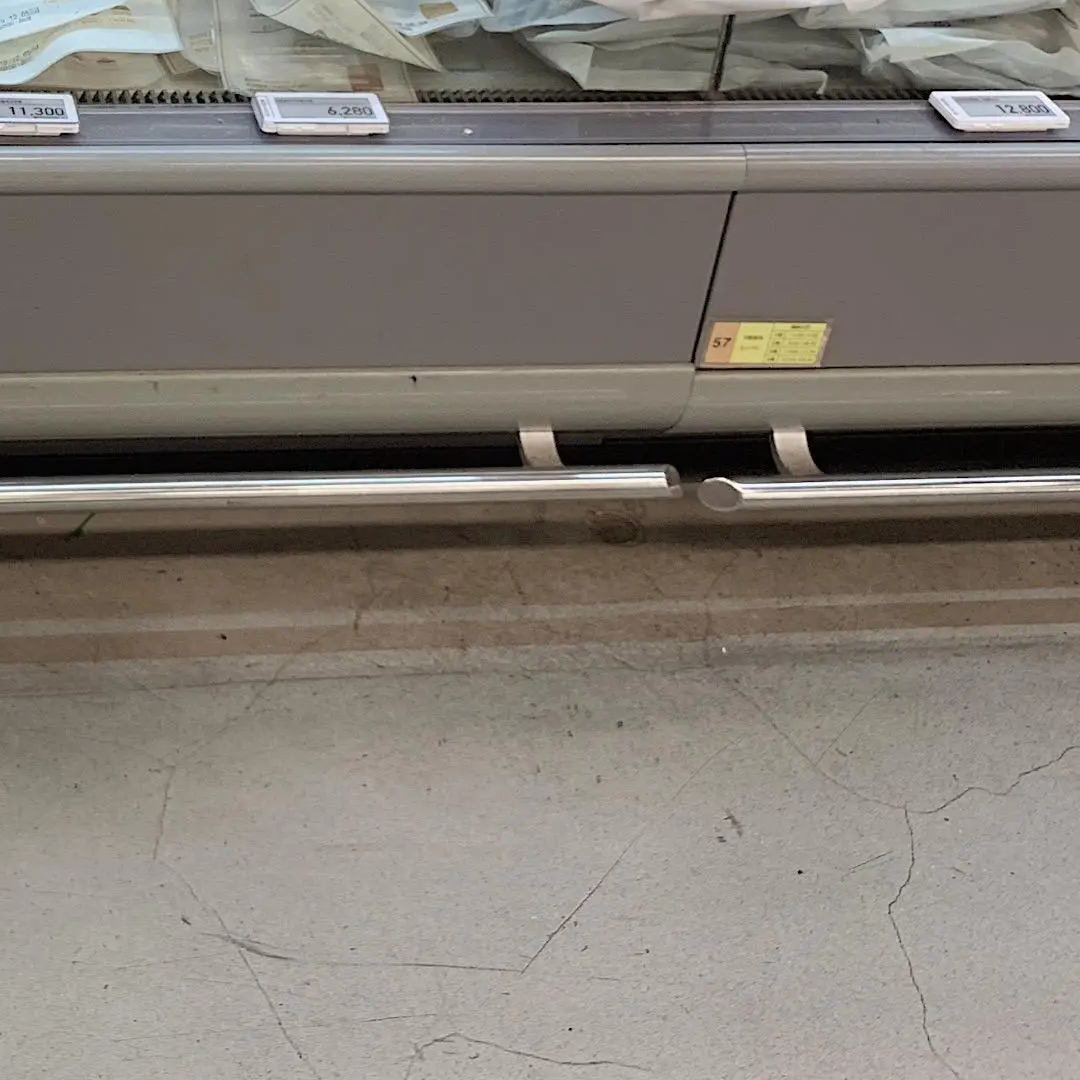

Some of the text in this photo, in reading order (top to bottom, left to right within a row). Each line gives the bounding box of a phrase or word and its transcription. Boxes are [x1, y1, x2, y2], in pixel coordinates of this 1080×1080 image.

[8, 106, 64, 117] 11,300
[327, 106, 373, 117] 6,280
[712, 336, 732, 349] 57
